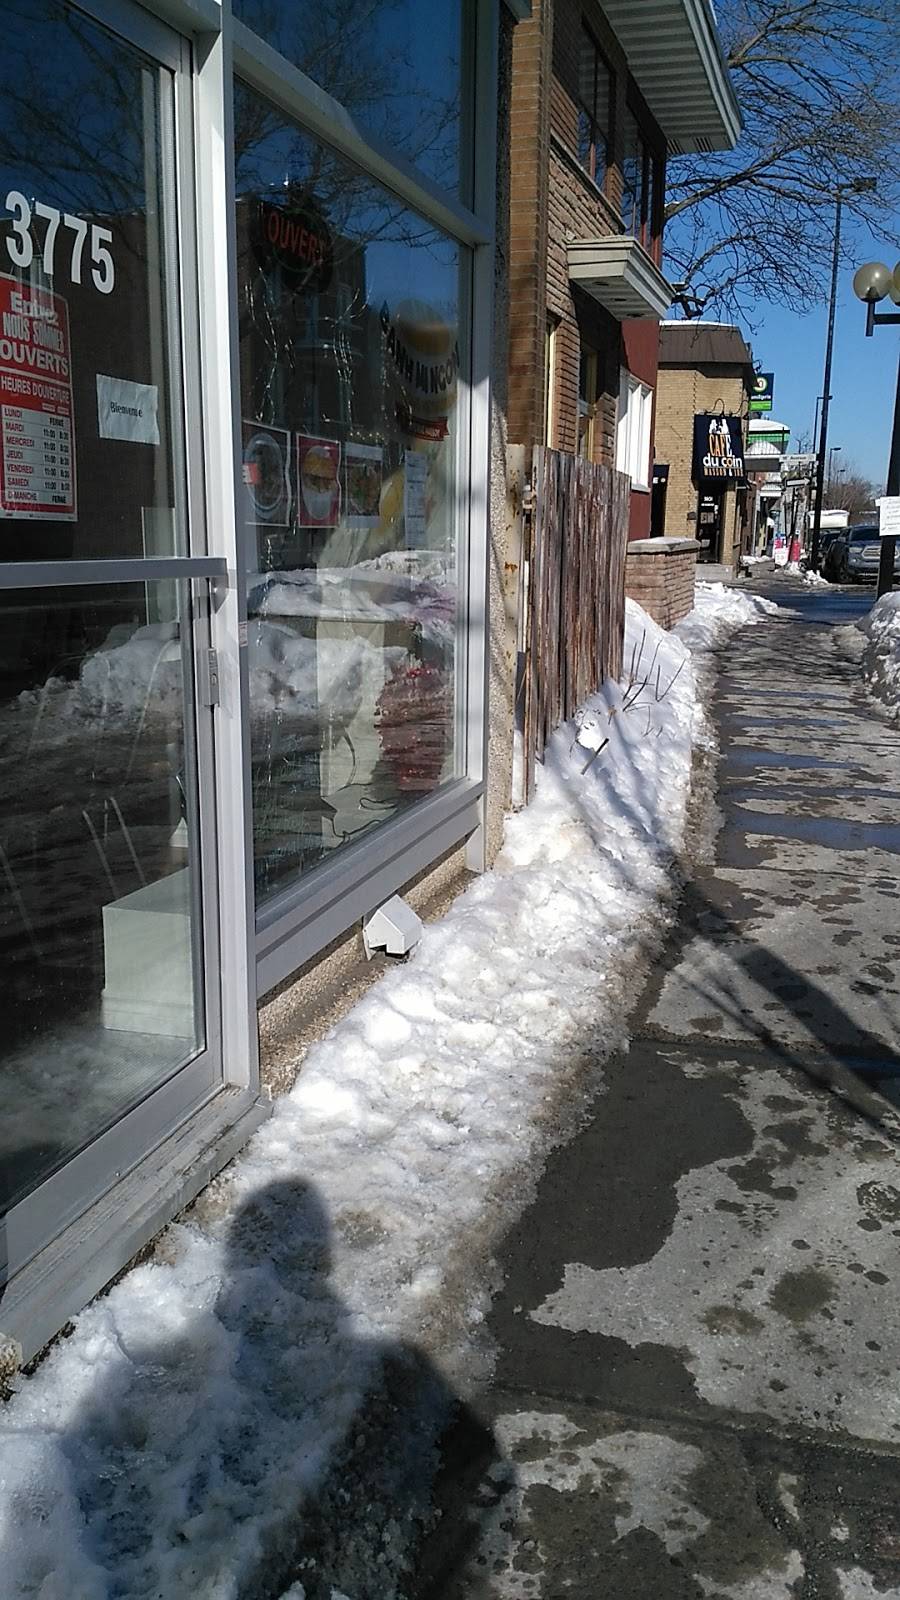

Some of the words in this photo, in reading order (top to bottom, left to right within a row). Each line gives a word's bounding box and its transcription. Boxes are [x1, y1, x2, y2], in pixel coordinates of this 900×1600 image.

[5, 190, 115, 294] 3775
[10, 290, 59, 327] Entrez
[2, 311, 30, 342] NOUS
[33, 320, 65, 353] SOMMES
[0, 339, 69, 376] OUVERTS
[1, 375, 32, 395] HEURES
[4, 407, 23, 418] LUNDI
[5, 421, 24, 432] MARDI
[6, 436, 35, 448] MERCREDI
[6, 449, 24, 459] JEUDI
[703, 452, 719, 467] du
[721, 455, 743, 468] coin
[7, 463, 34, 474] VENDREDI
[7, 477, 29, 487] SAMEDI
[8, 490, 37, 501] DMANCHE
